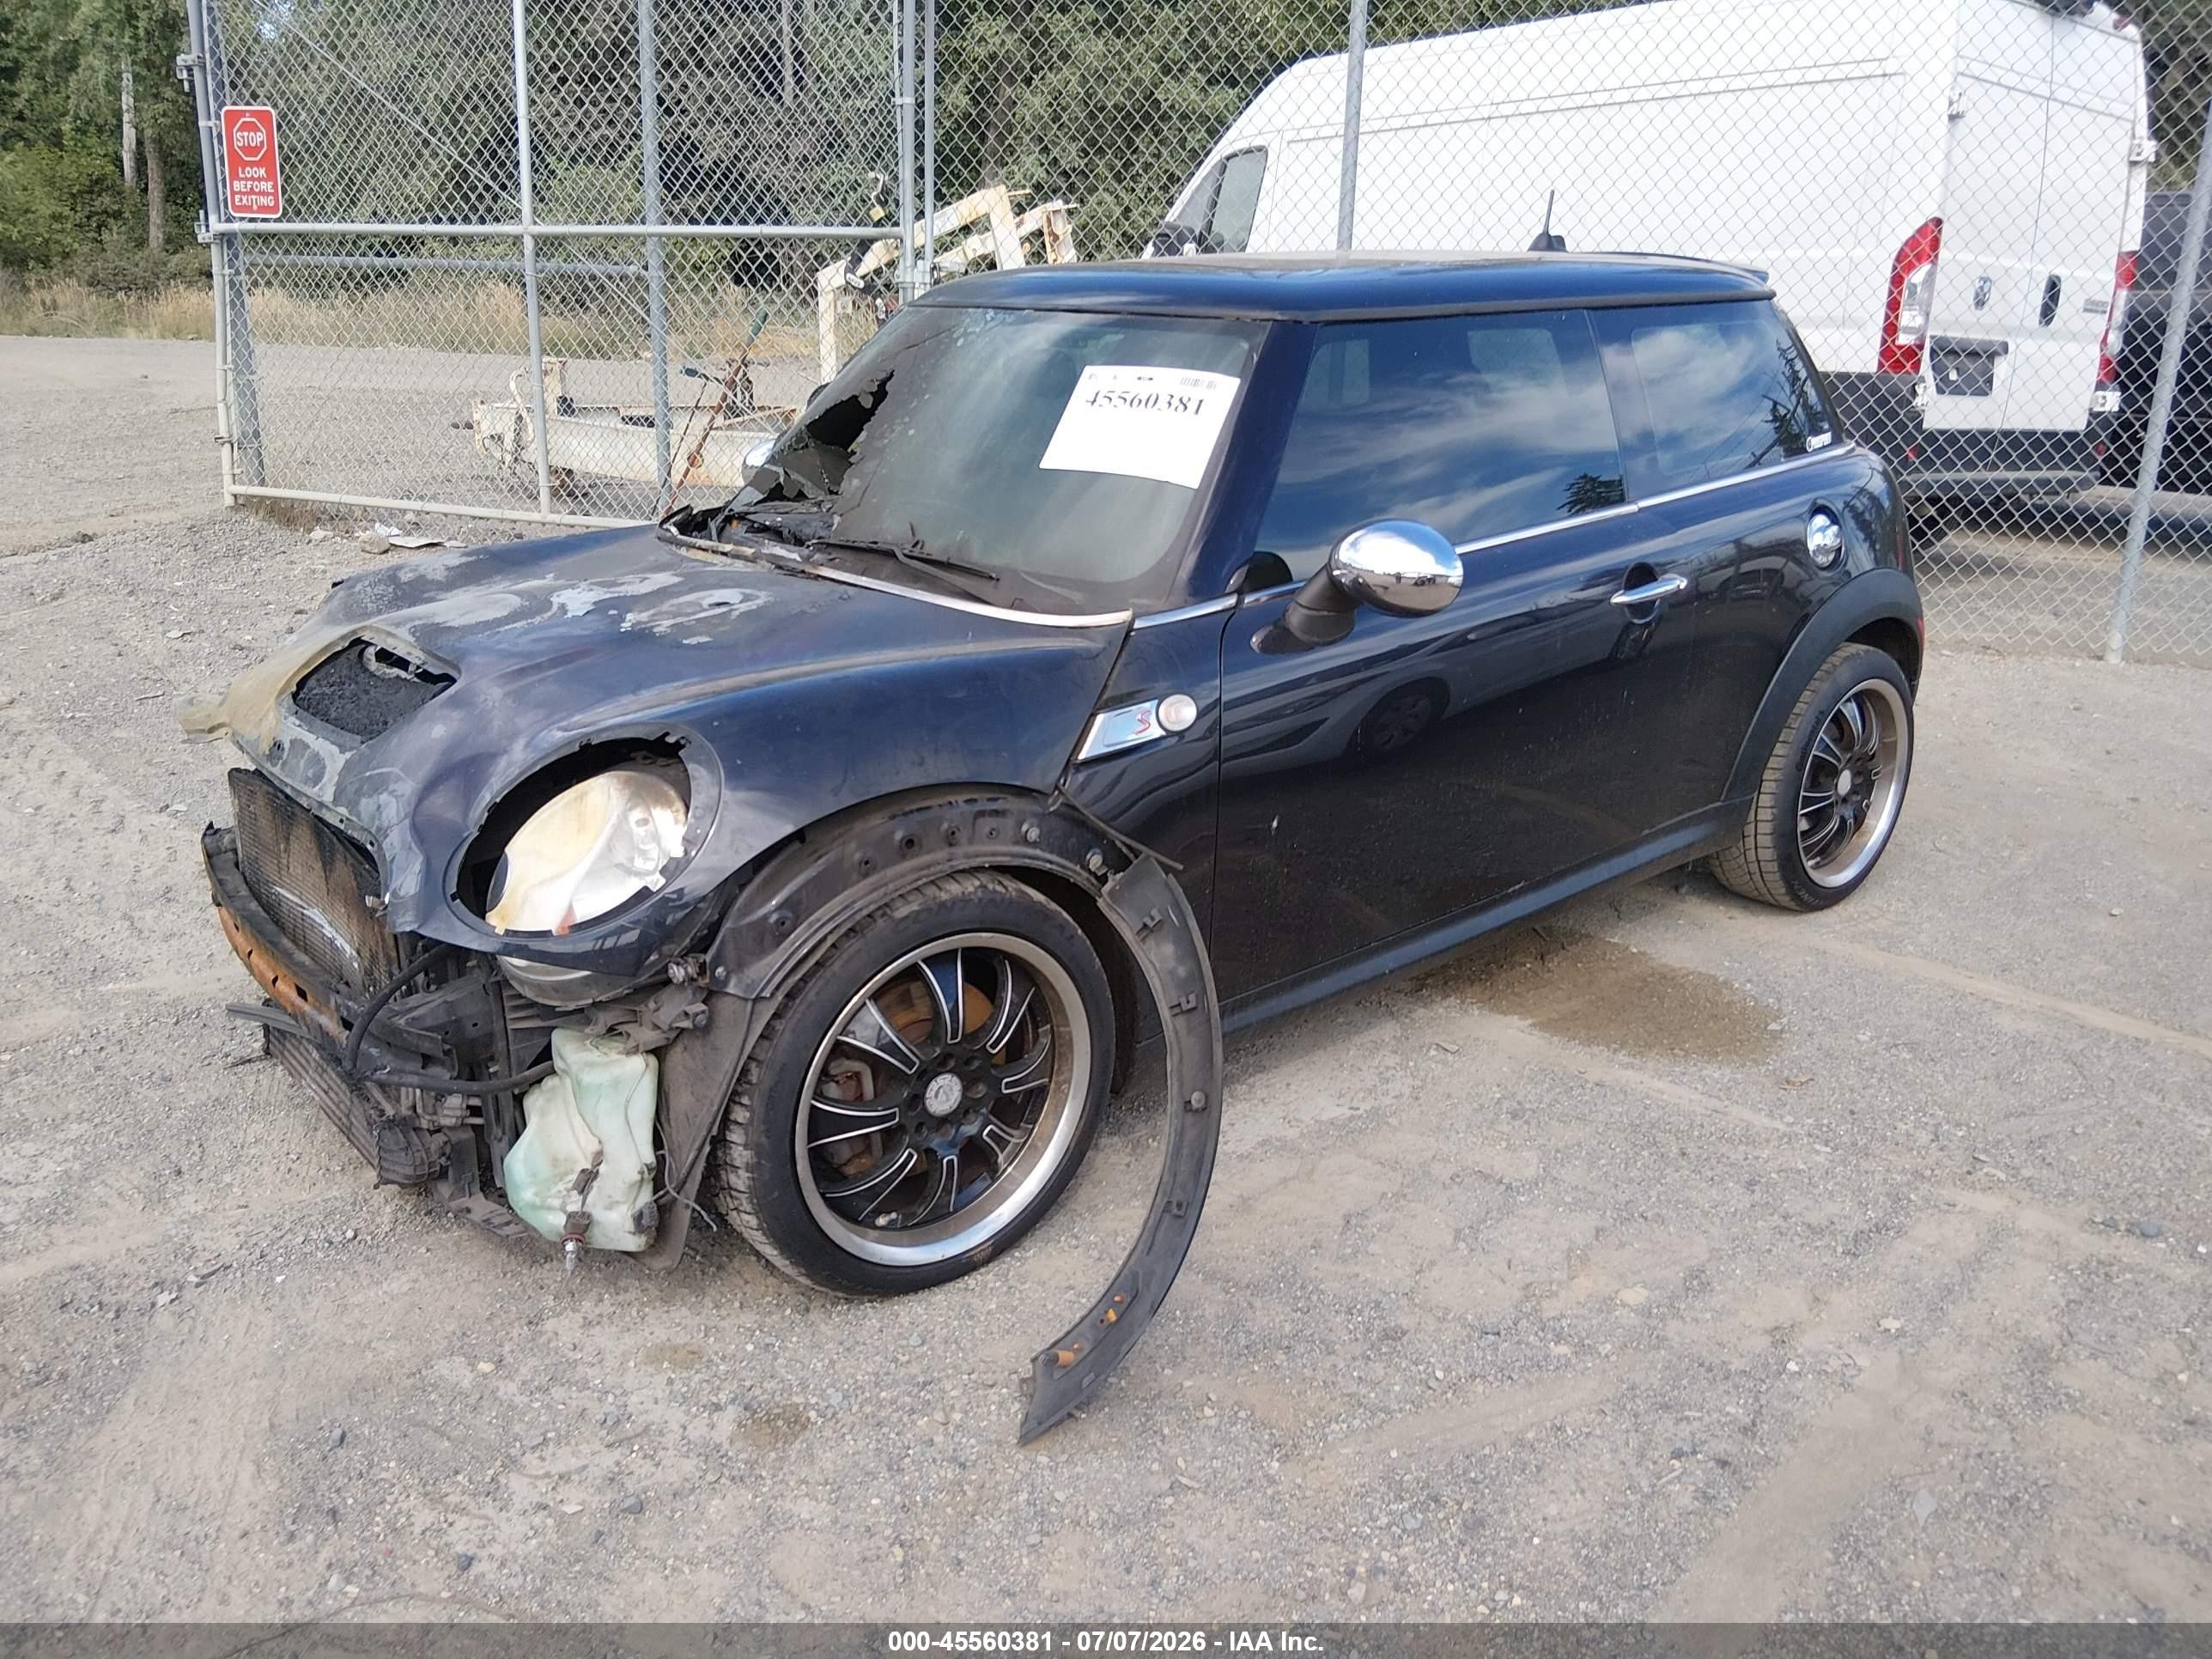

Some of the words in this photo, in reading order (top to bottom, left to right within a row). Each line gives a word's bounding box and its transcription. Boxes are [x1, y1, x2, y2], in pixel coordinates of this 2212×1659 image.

[236, 131, 264, 147] STOP
[239, 167, 266, 179] LOOK
[233, 181, 274, 192] BEFORE
[234, 195, 275, 207] EXITING
[1085, 389, 1205, 416] 45560381
[1133, 709, 1152, 736] S
